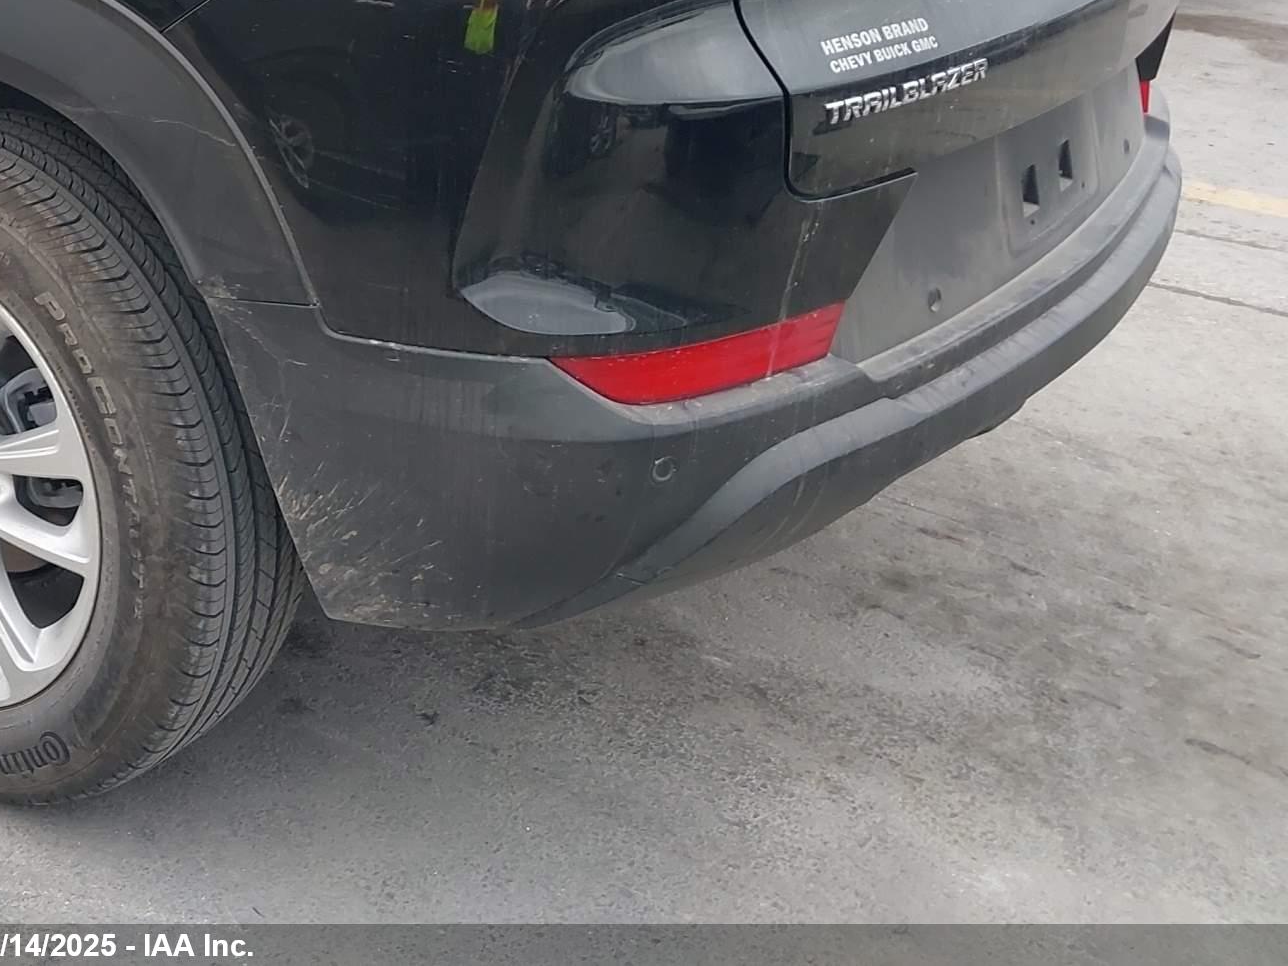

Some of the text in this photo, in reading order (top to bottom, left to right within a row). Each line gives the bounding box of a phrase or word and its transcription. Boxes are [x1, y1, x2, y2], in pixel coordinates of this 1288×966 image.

[820, 17, 929, 56] HENSON BRAND
[829, 36, 939, 74] CHEVY BUICK GMC
[824, 58, 989, 125] TRAILBLAZER
